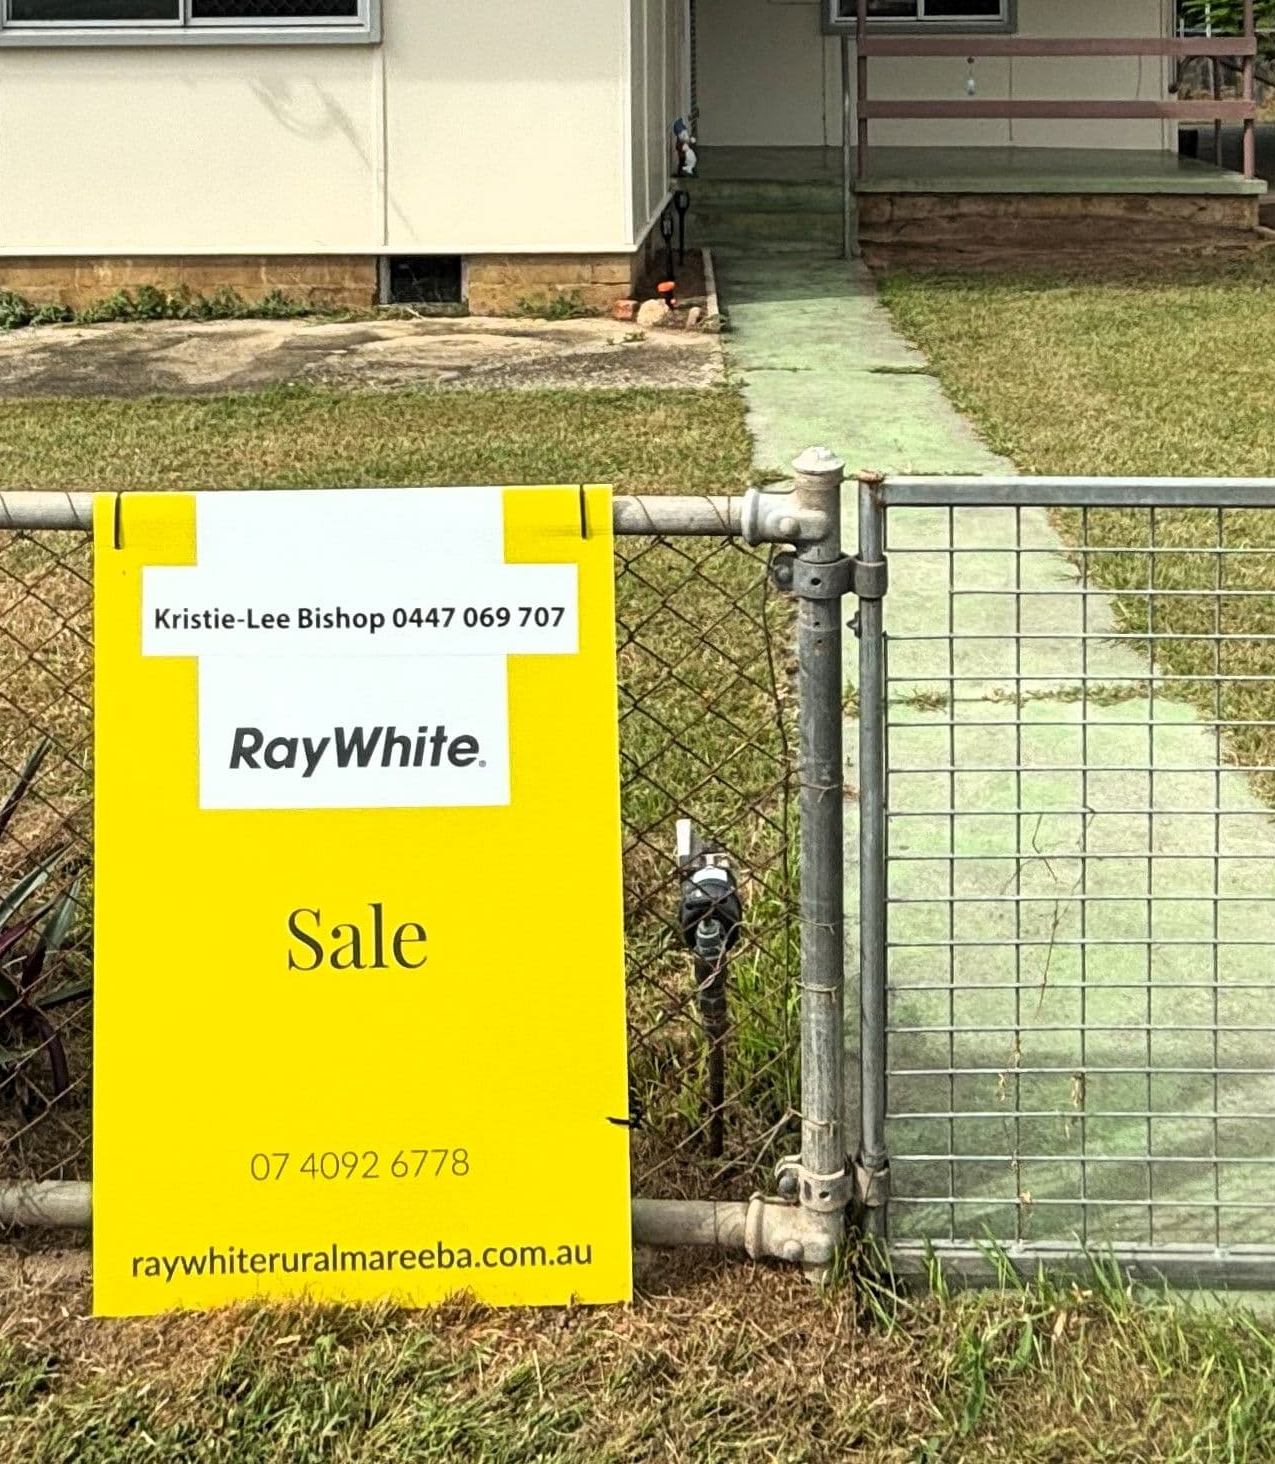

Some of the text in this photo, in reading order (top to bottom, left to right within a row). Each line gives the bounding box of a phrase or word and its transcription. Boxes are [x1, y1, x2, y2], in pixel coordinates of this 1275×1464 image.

[154, 606, 566, 634] Kristie-Lee Bishop 0447 069 707
[287, 902, 428, 971] Sale
[250, 1147, 471, 1182] 07 4092 6778
[131, 1240, 593, 1284] raywhiteruralmareeba.com.au
